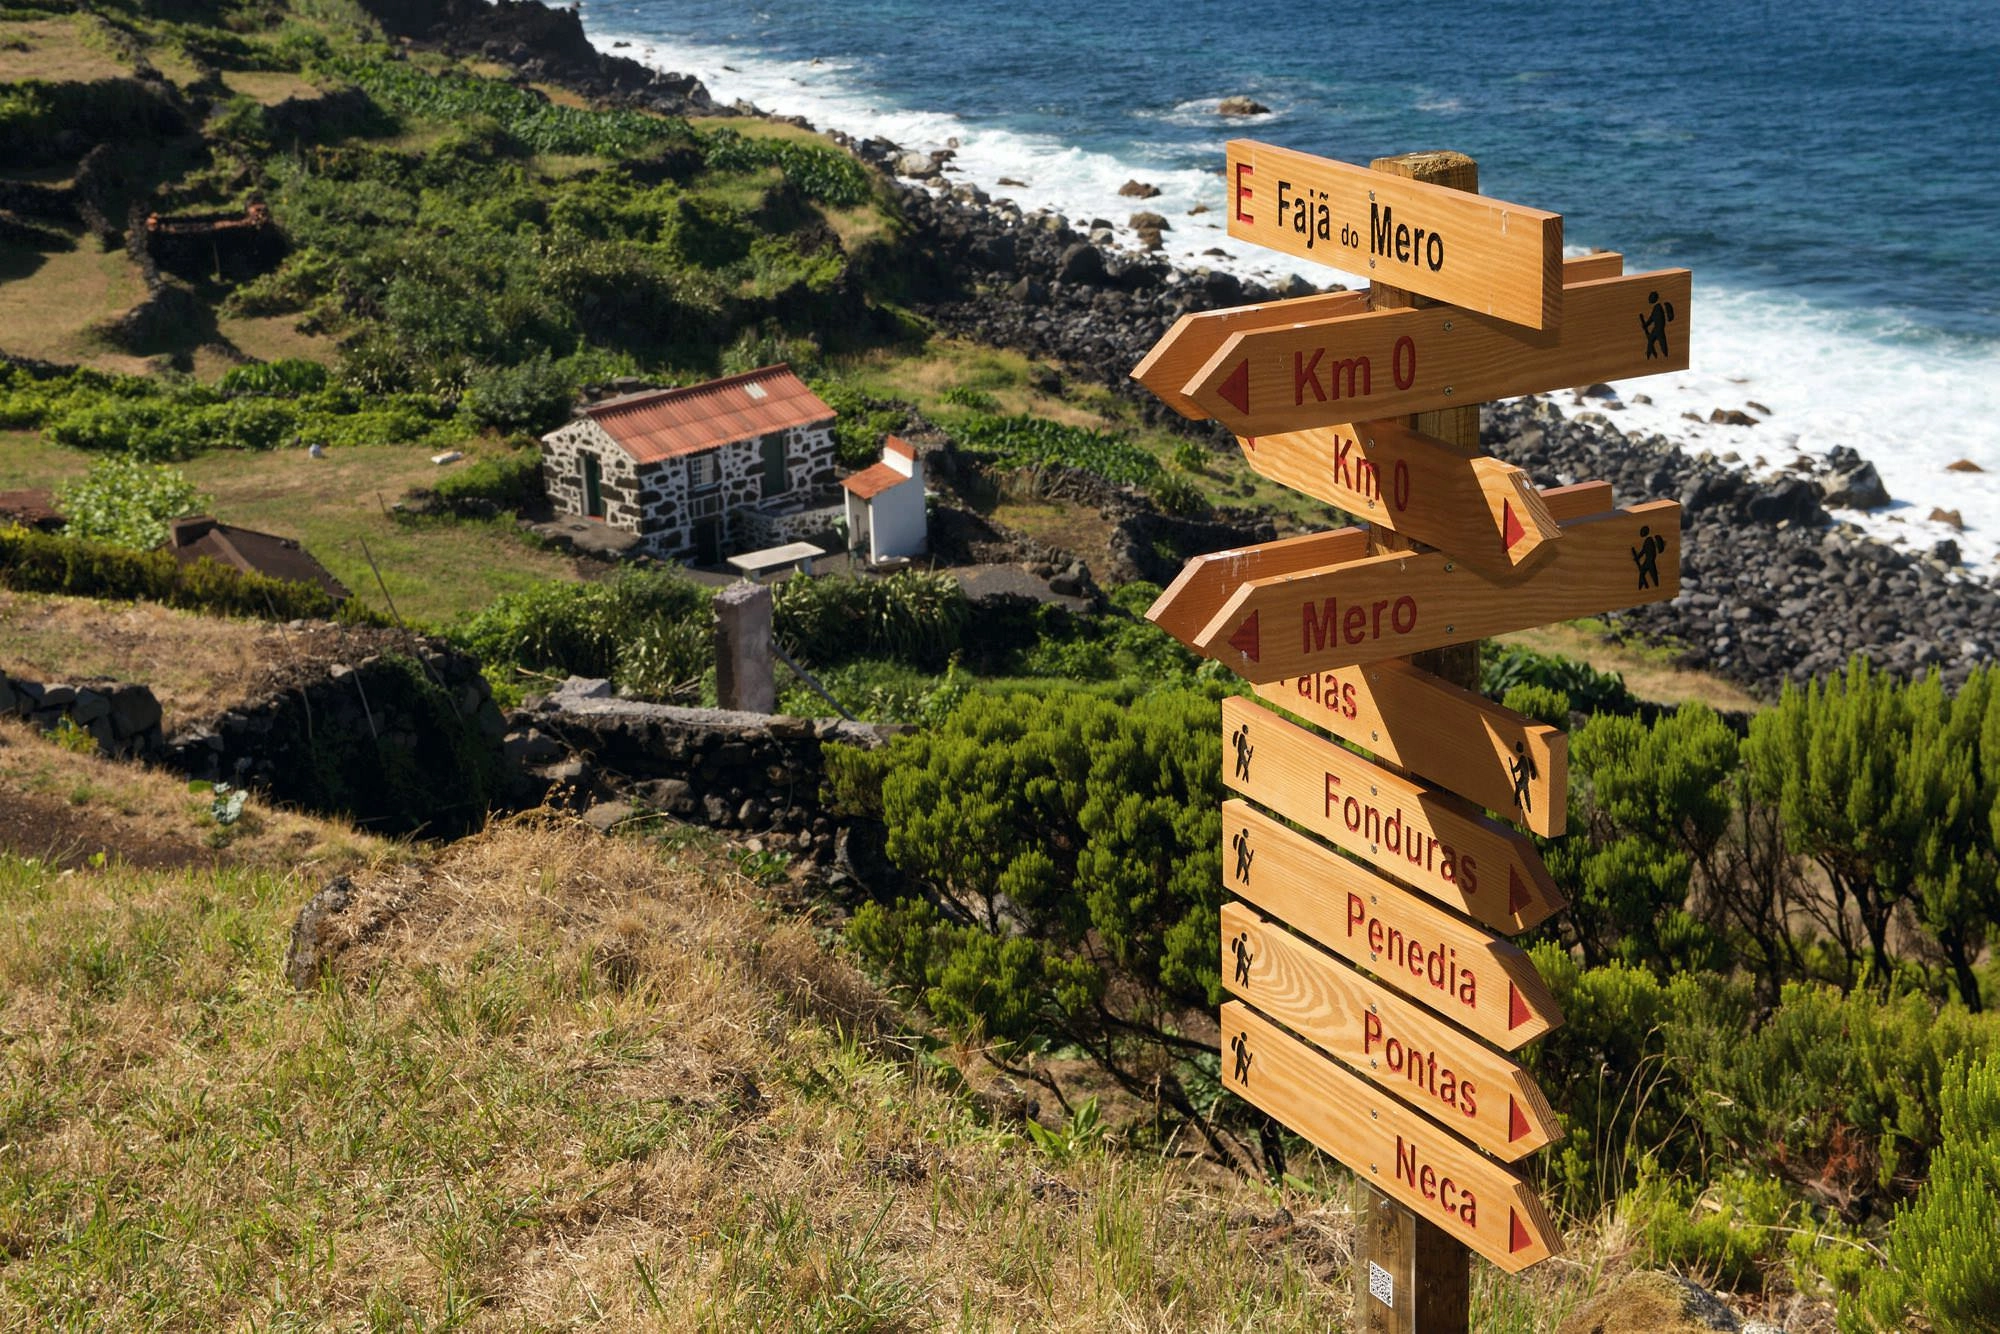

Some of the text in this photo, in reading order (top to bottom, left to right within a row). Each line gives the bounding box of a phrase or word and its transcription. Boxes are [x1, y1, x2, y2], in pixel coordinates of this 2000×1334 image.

[1236, 162, 1444, 273] E Fajã do Mero
[1294, 335, 1416, 406] Km 0
[1334, 434, 1410, 512] Km 0
[1303, 594, 1418, 654] Mero
[1279, 671, 1358, 721] alas
[1324, 771, 1478, 894] Fonduras
[1347, 892, 1477, 1008] Penedia
[1364, 1009, 1478, 1118] Pontas
[1395, 1134, 1478, 1228] Neca
